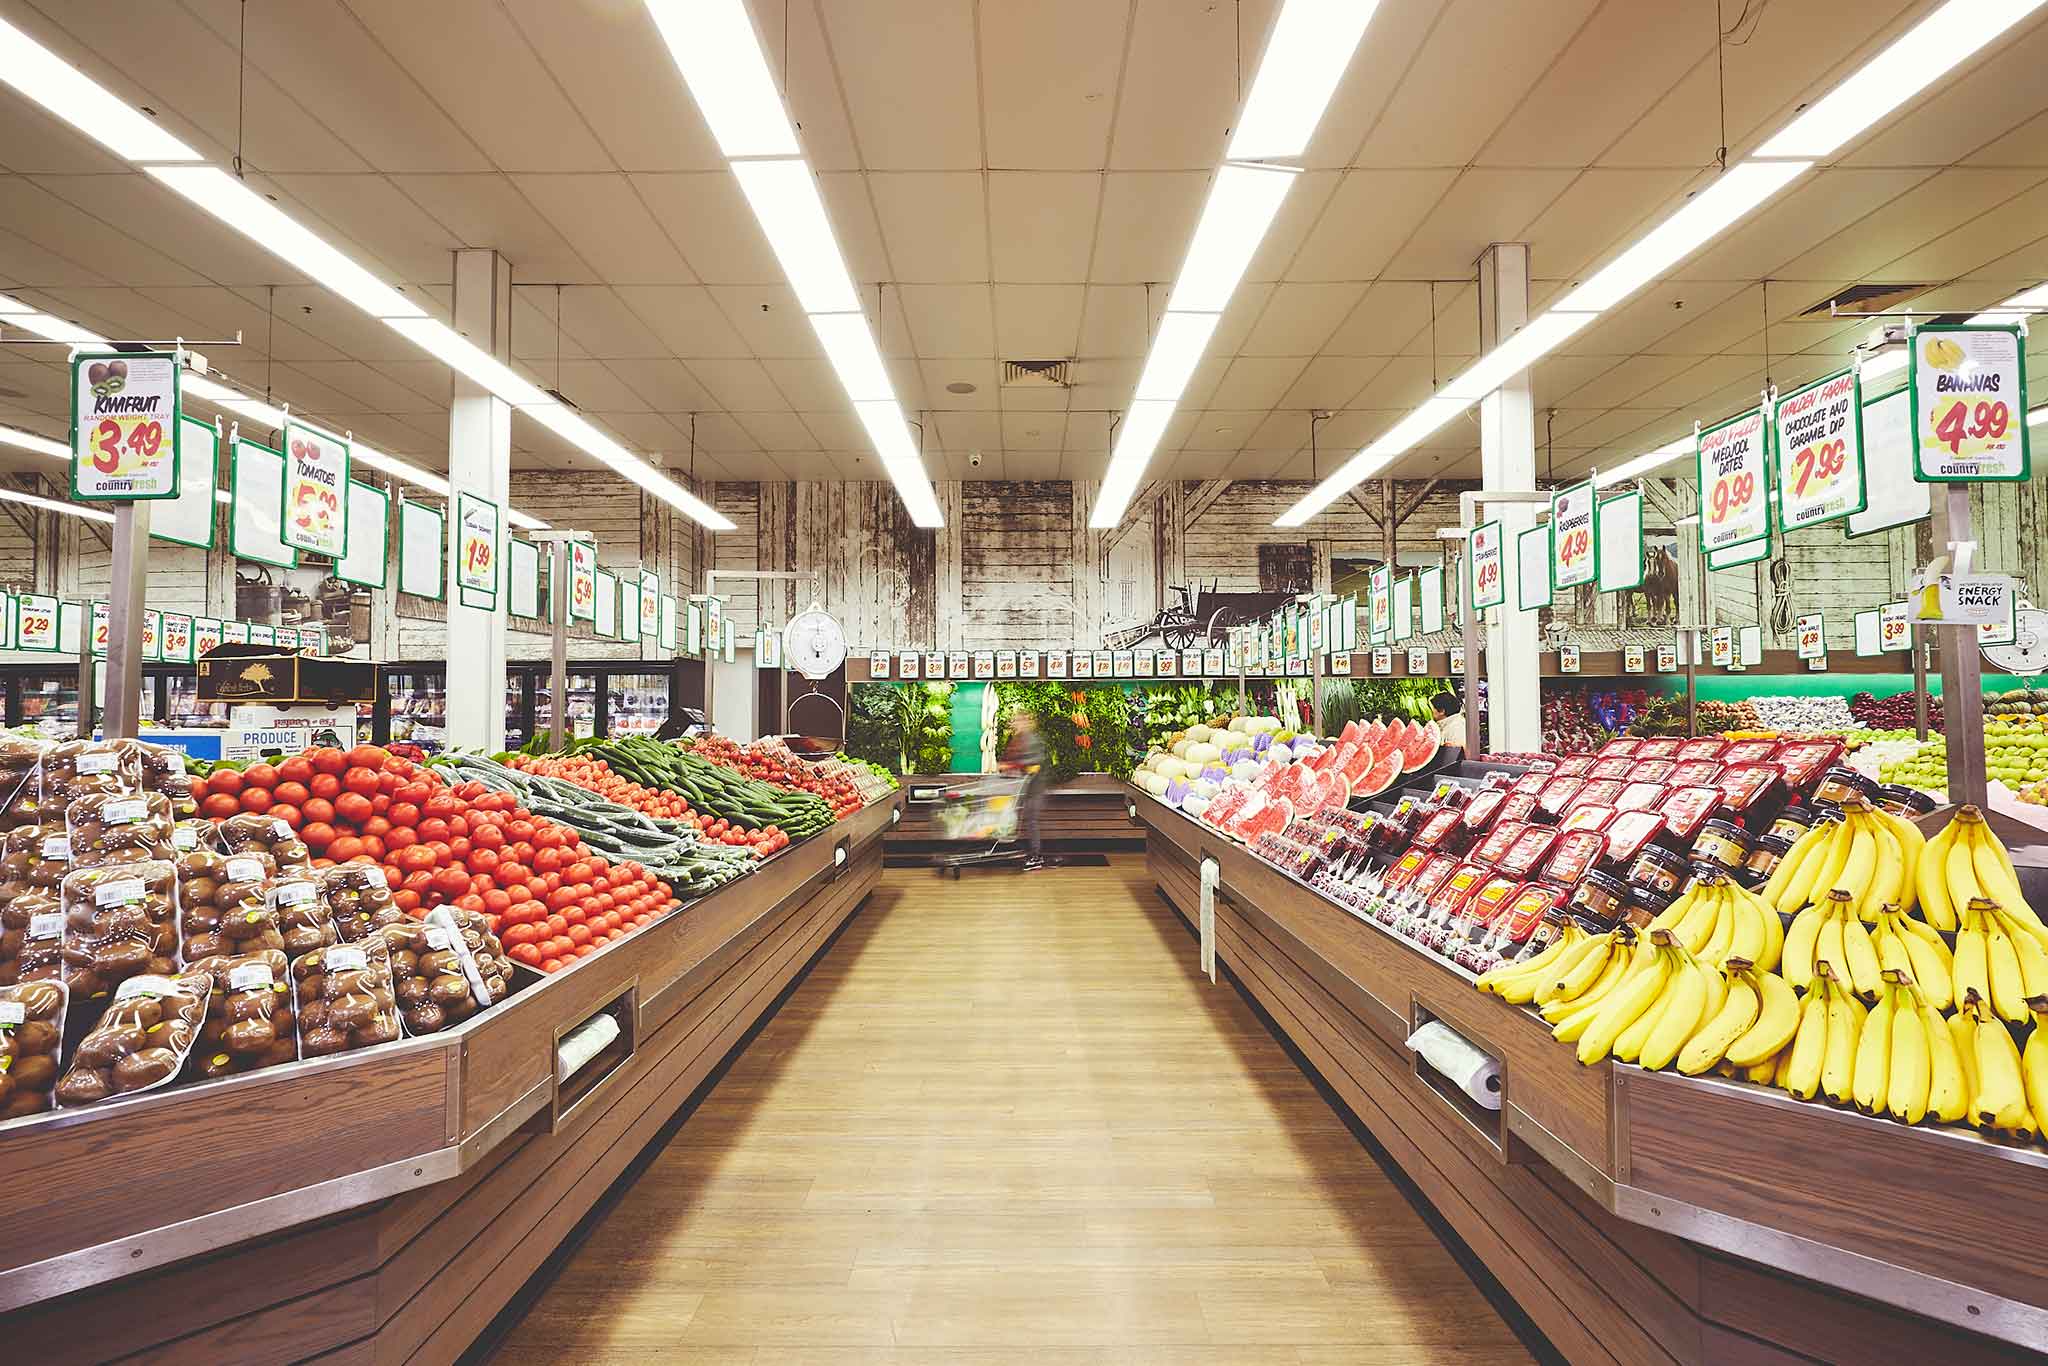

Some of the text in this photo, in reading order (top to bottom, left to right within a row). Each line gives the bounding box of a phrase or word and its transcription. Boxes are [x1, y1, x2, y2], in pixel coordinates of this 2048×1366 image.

[1936, 373, 2000, 393] BANANAS
[94, 395, 161, 415] KIWIFRUIT
[1780, 376, 1853, 419] WALDEN FARMS
[1785, 398, 1848, 436] CHOCOLATE AND
[1935, 400, 2008, 455] 4.99
[93, 420, 162, 474] 3.49
[1790, 417, 1845, 450] CARAMEL DIP
[1712, 438, 1749, 465] MEDJOOL
[297, 459, 335, 486] TOMATOES
[1719, 456, 1743, 477] DATES
[1711, 471, 1754, 524] 9.99
[469, 538, 490, 572] 1.99
[1561, 529, 1588, 568] 4.99
[1478, 562, 1498, 592] 4.99
[1958, 586, 2003, 595] ENERGY
[1958, 596, 2001, 606] SNACK
[166, 634, 186, 651] 3.49
[244, 731, 297, 745] PRODUCE
